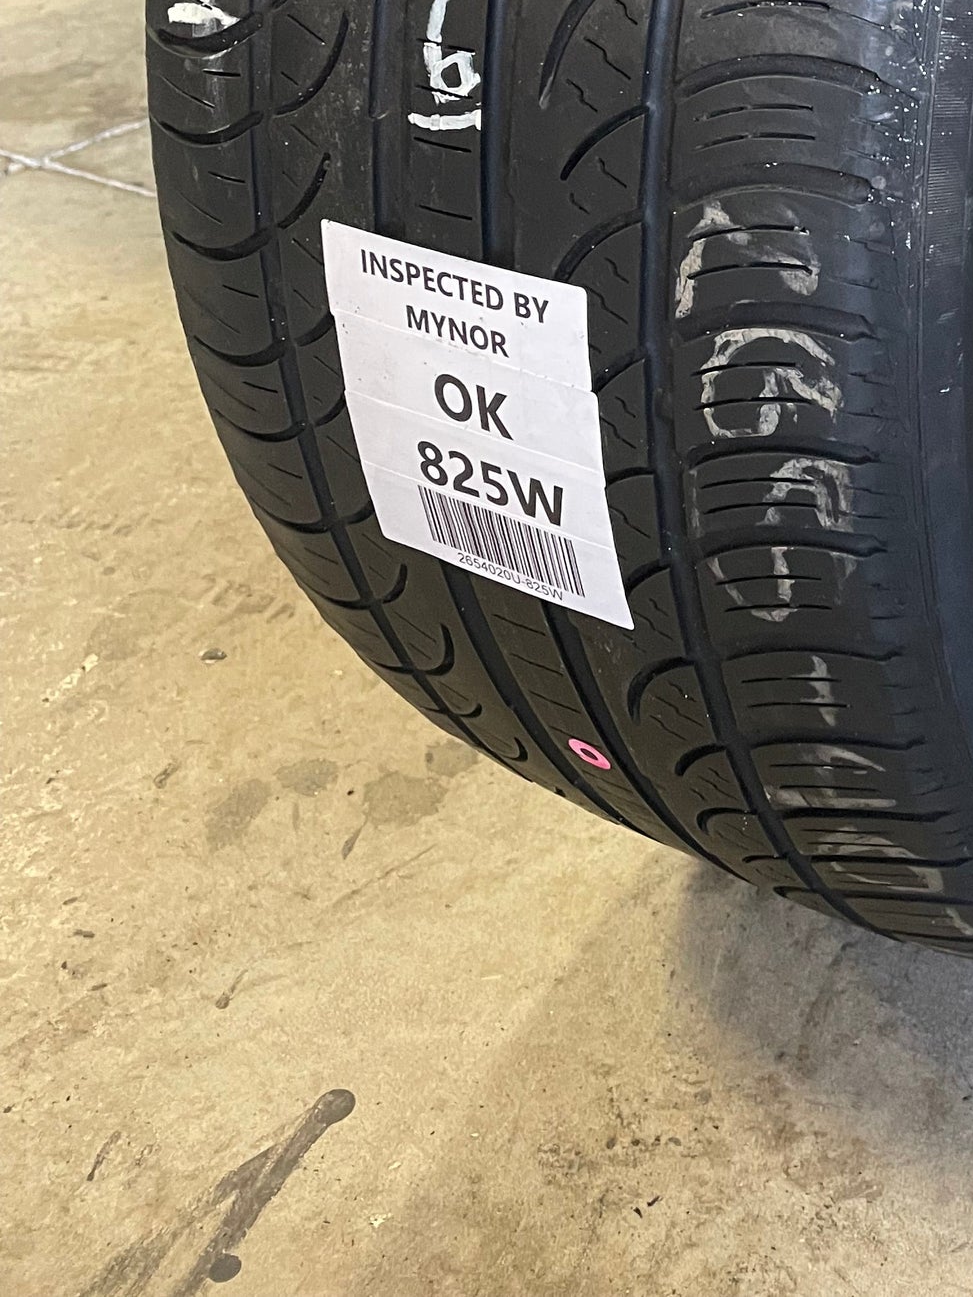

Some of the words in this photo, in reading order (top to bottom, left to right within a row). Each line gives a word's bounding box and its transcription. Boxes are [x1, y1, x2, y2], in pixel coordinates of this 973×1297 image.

[360, 248, 504, 311] INSPECTED
[513, 291, 550, 324] BY
[406, 304, 510, 358] MYNOR
[434, 373, 514, 441] OK
[416, 440, 564, 527] 825W
[457, 551, 564, 602] 2654020U-825W
